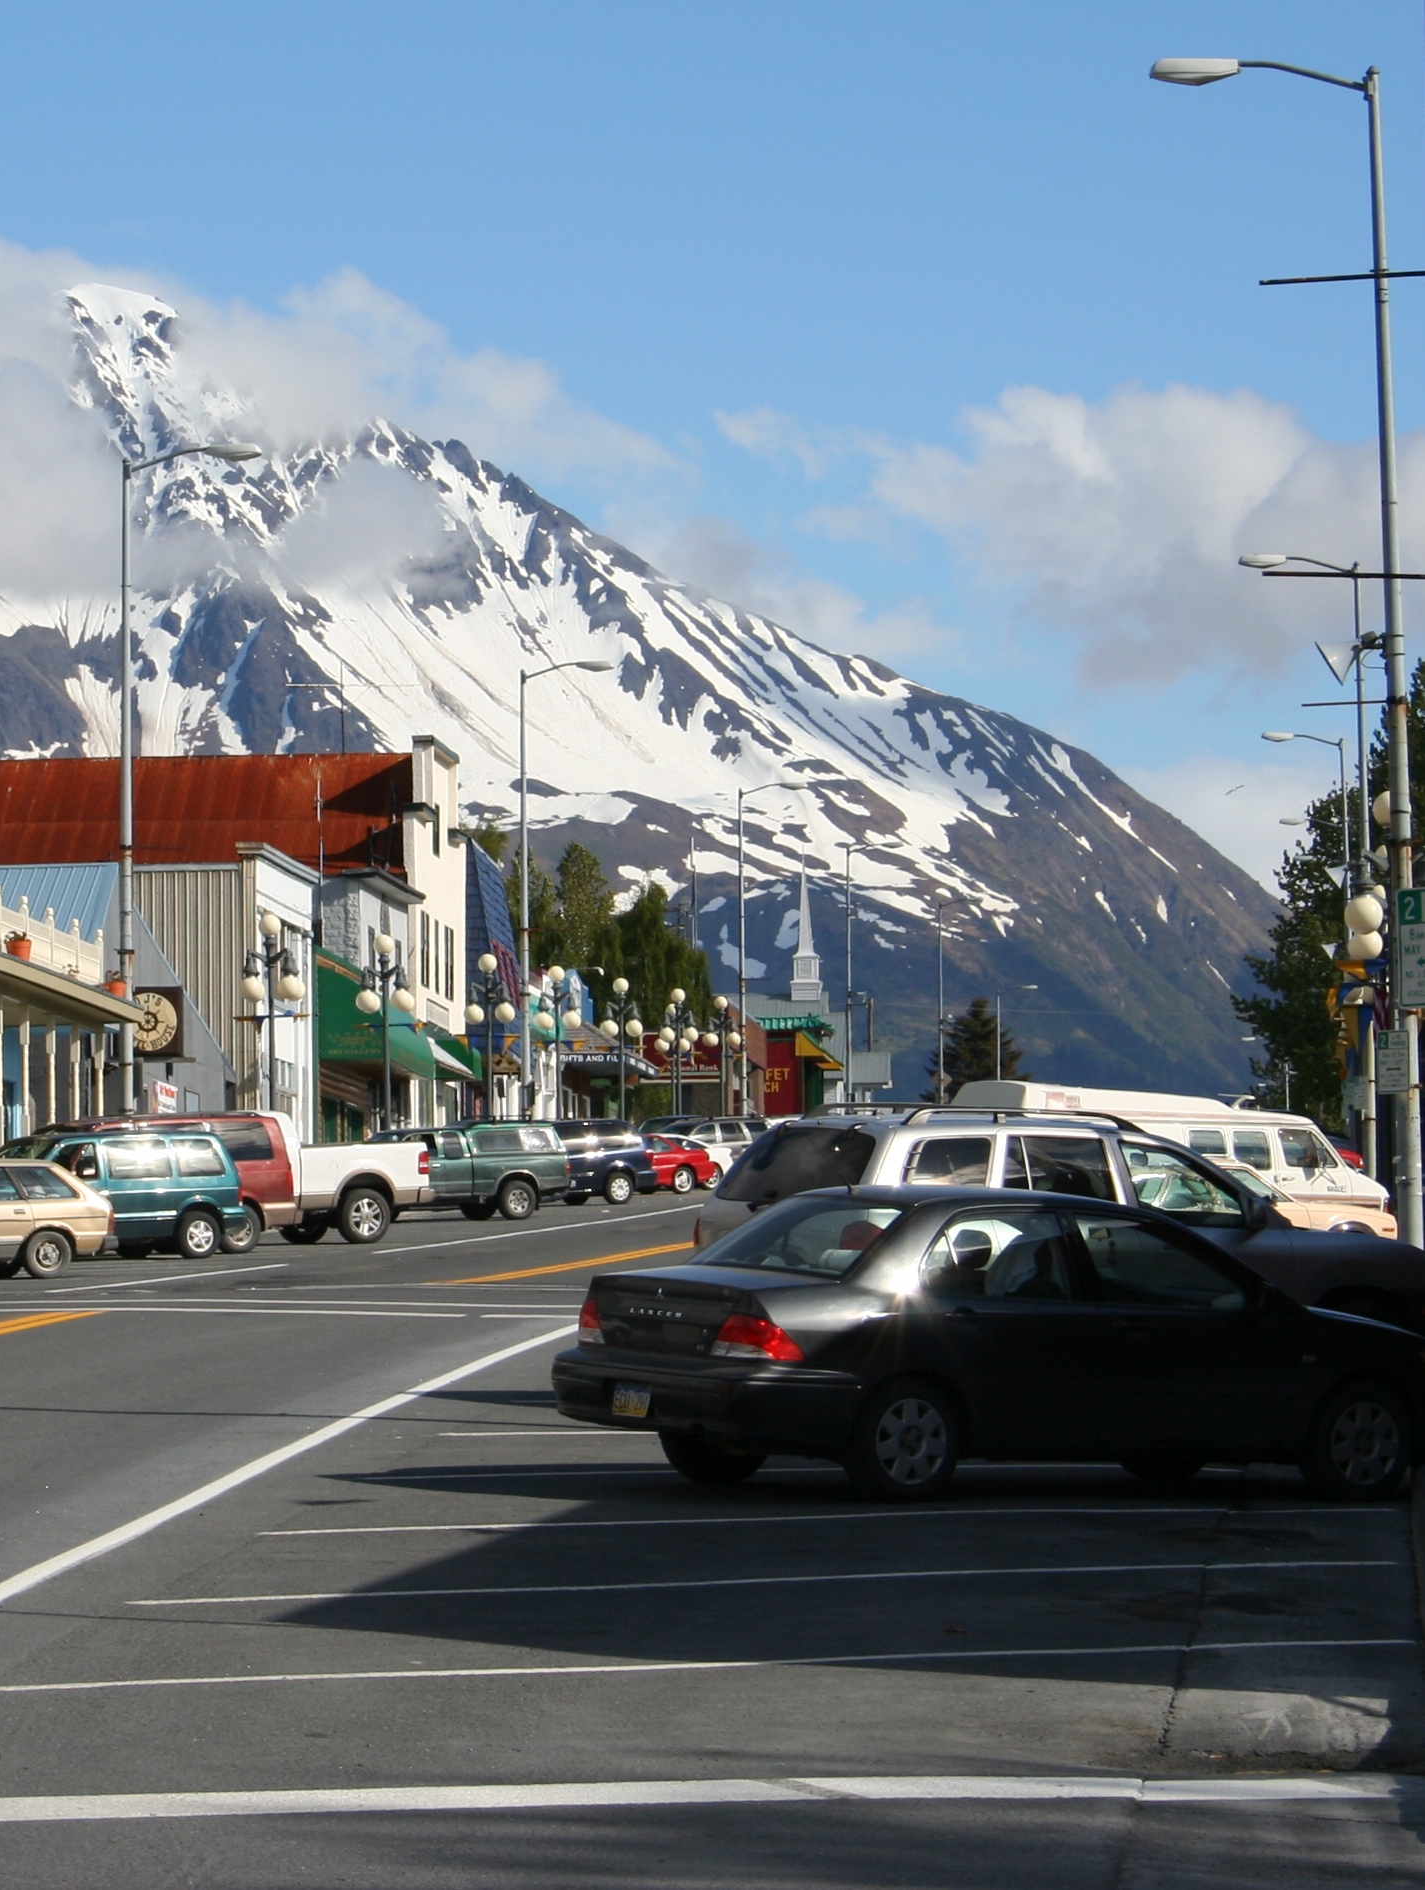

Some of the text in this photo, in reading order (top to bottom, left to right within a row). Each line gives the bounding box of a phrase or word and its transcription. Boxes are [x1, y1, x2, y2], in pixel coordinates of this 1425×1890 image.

[1403, 896, 1416, 920] 2
[1404, 945, 1421, 956] MAY
[150, 1023, 177, 1050] HOUSE
[559, 1054, 584, 1063] GIFTS
[585, 1054, 604, 1062] AND
[699, 1063, 719, 1072] Bank
[765, 1068, 790, 1081] FET
[629, 1307, 683, 1318] LANCER
